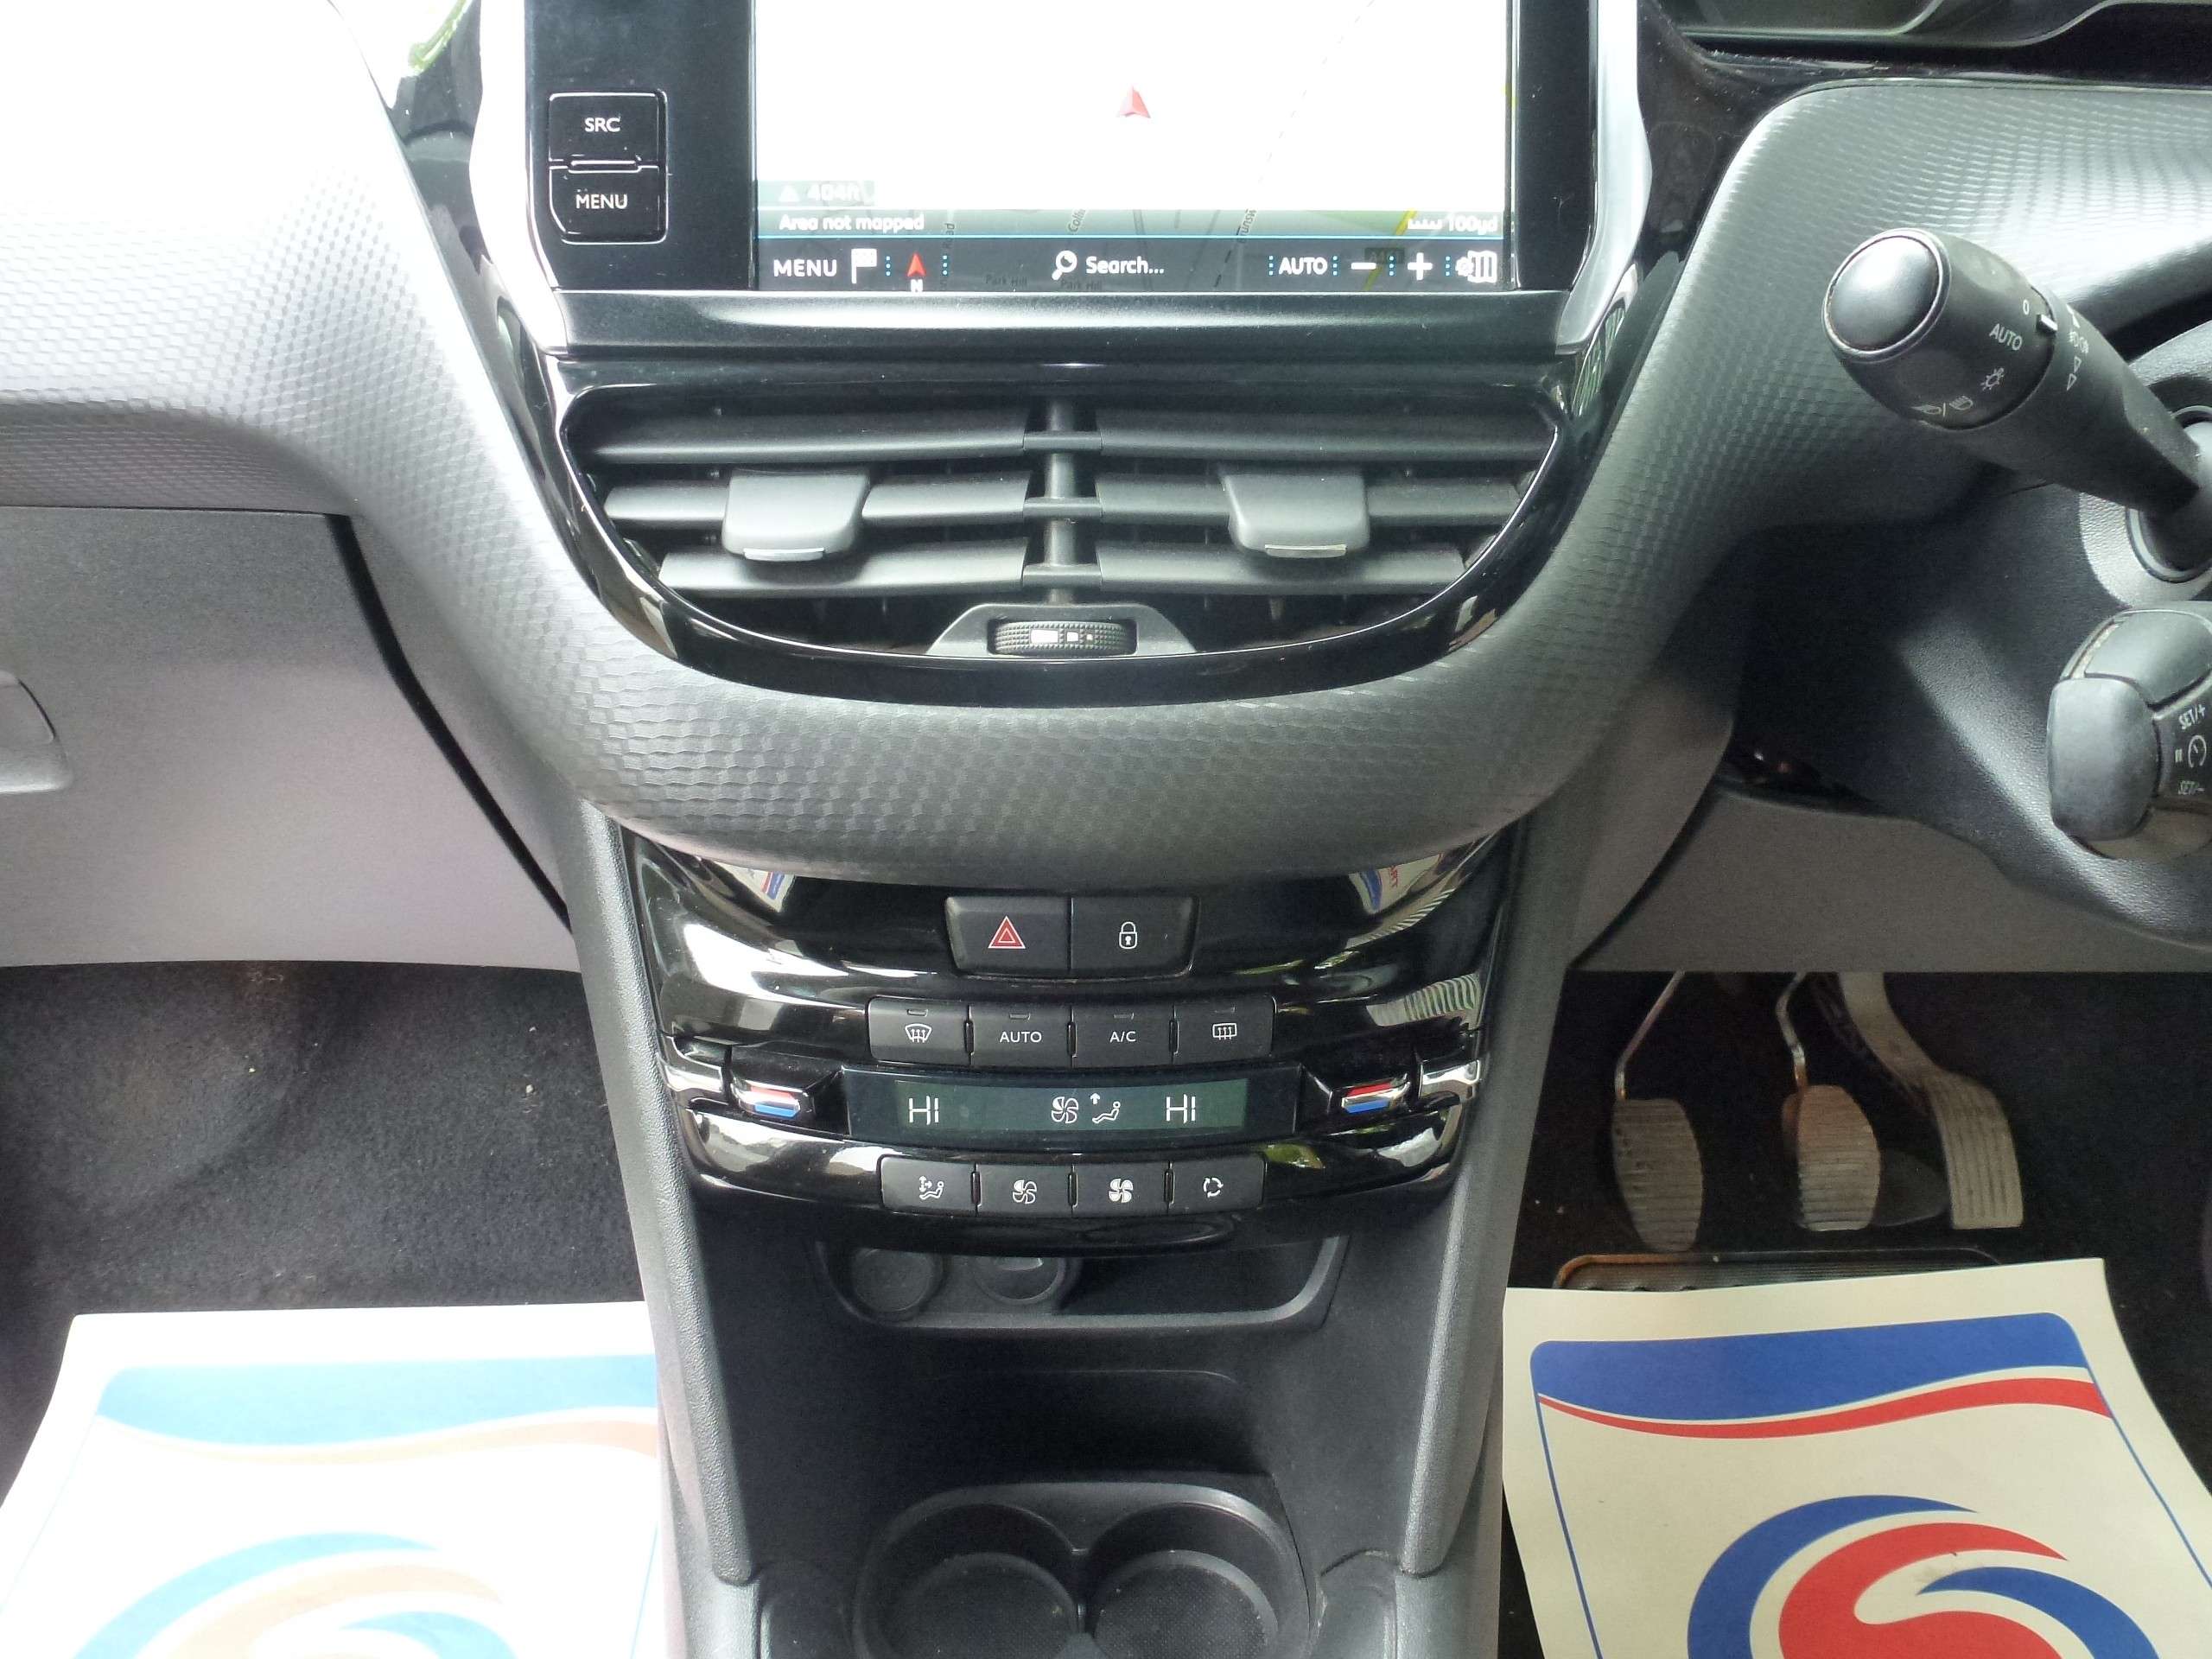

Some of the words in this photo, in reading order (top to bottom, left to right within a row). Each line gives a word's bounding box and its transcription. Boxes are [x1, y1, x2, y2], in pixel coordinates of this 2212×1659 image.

[584, 118, 621, 133] SRC
[575, 194, 628, 209] MENU
[779, 214, 818, 231] Area
[823, 214, 852, 231] not
[855, 214, 925, 234] mapped
[1448, 215, 1498, 235] 100yd
[773, 258, 837, 277] MENU
[1085, 256, 1165, 274] Search...
[1278, 256, 1329, 276] AUTO
[910, 278, 924, 293] N
[1988, 322, 2023, 351] AUTO
[999, 1031, 1042, 1043] AUTO
[1109, 1031, 1136, 1043] A/C
[907, 1095, 940, 1126] HI
[1165, 1093, 1198, 1124] HI
